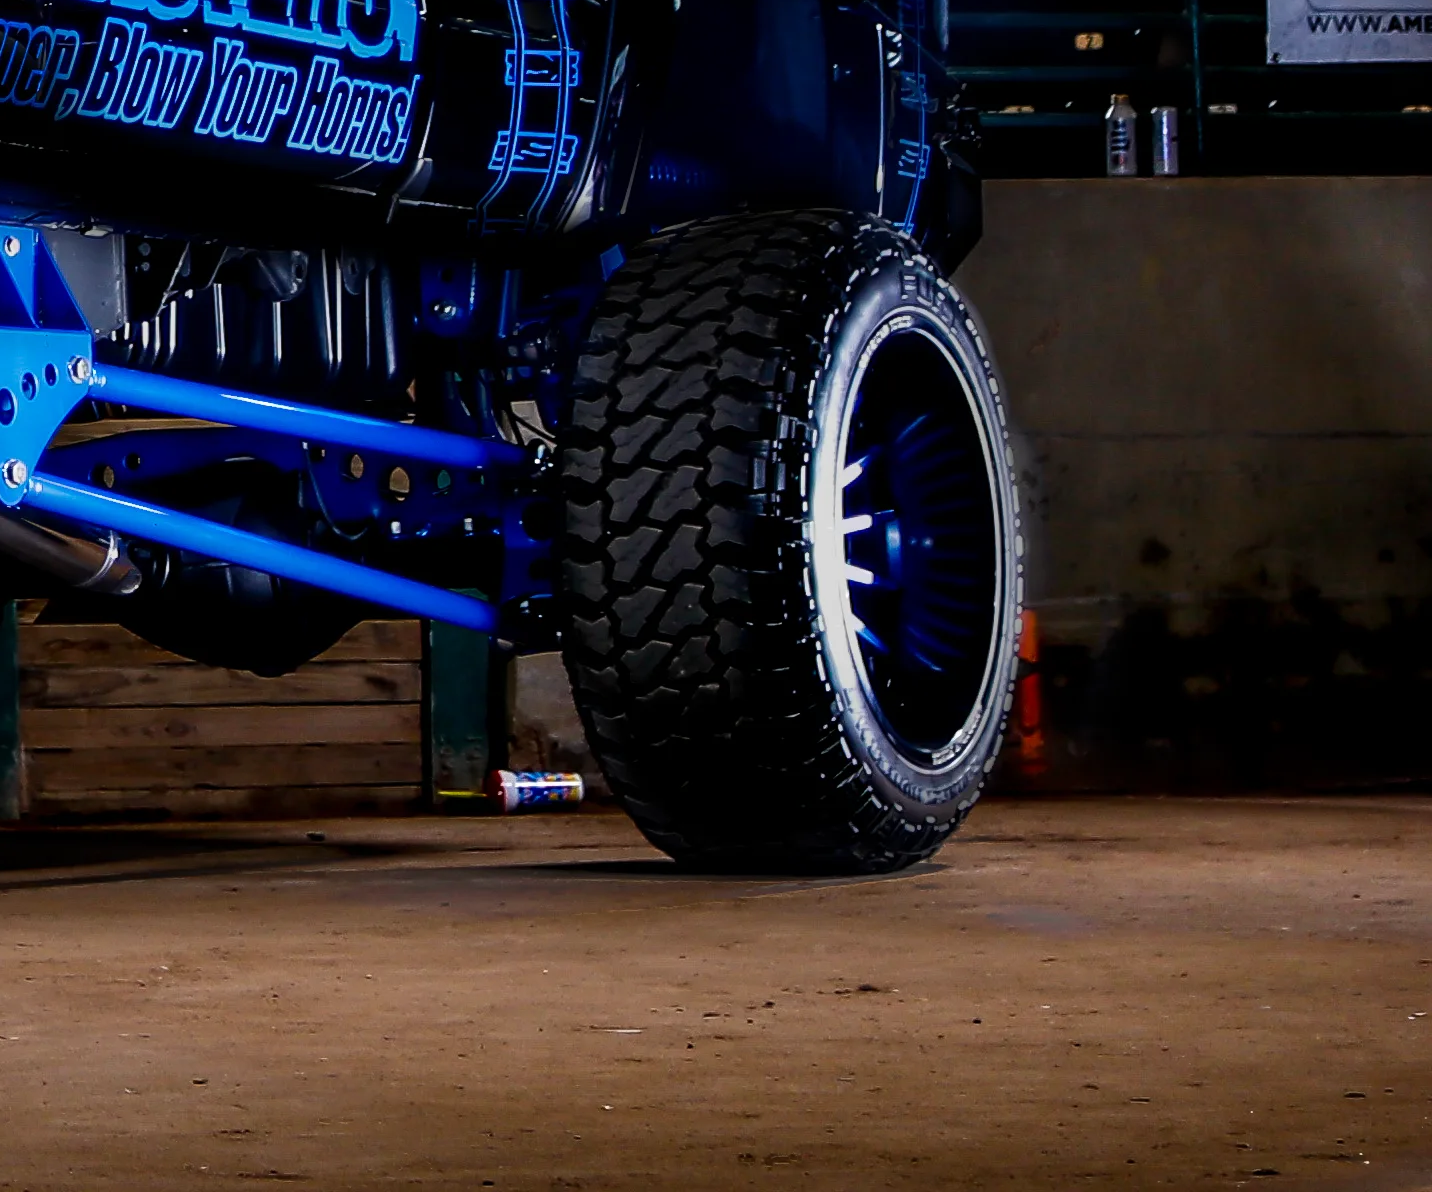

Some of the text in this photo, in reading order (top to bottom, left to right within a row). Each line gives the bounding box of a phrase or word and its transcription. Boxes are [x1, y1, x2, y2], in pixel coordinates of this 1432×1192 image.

[77, 16, 204, 130] Blow
[194, 36, 298, 144] Your
[287, 54, 422, 165] Horns!
